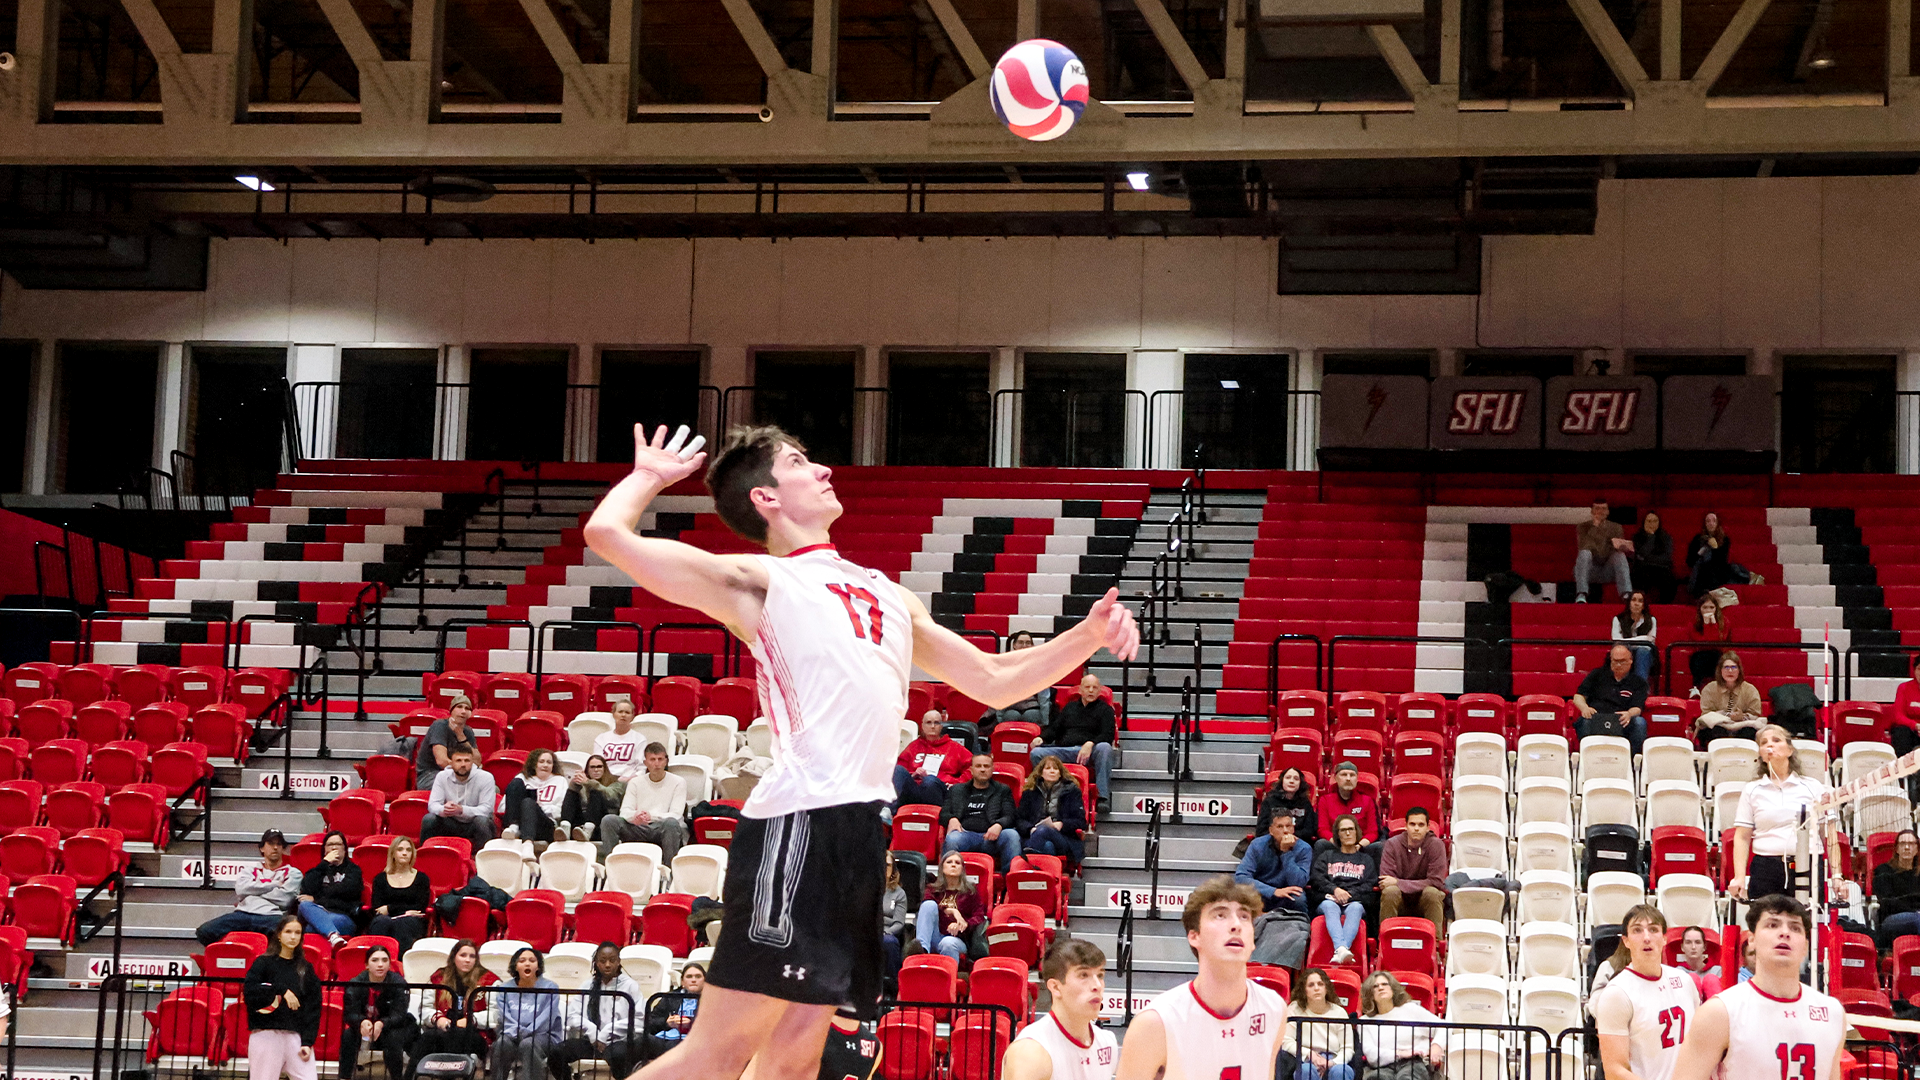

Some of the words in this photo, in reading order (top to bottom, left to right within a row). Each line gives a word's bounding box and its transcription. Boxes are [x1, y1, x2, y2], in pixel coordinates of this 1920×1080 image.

[1448, 390, 1526, 434] SFU
[1561, 390, 1639, 434] SFU
[826, 583, 884, 646] 17
[603, 743, 635, 761] SFU
[269, 774, 280, 790] A
[286, 777, 326, 788] ECTION
[329, 775, 339, 791] B
[1145, 798, 1156, 813] B
[1159, 801, 1205, 812] SETION
[1208, 799, 1219, 816] C
[192, 861, 204, 877] A
[1120, 890, 1131, 907] B
[1135, 894, 1184, 905] SETION
[100, 959, 111, 977] A
[168, 961, 179, 977] B
[1809, 1005, 1829, 1022] SFU
[1658, 1005, 1685, 1049] 27
[860, 1039, 876, 1058] SFU
[1775, 1042, 1816, 1080] 13
